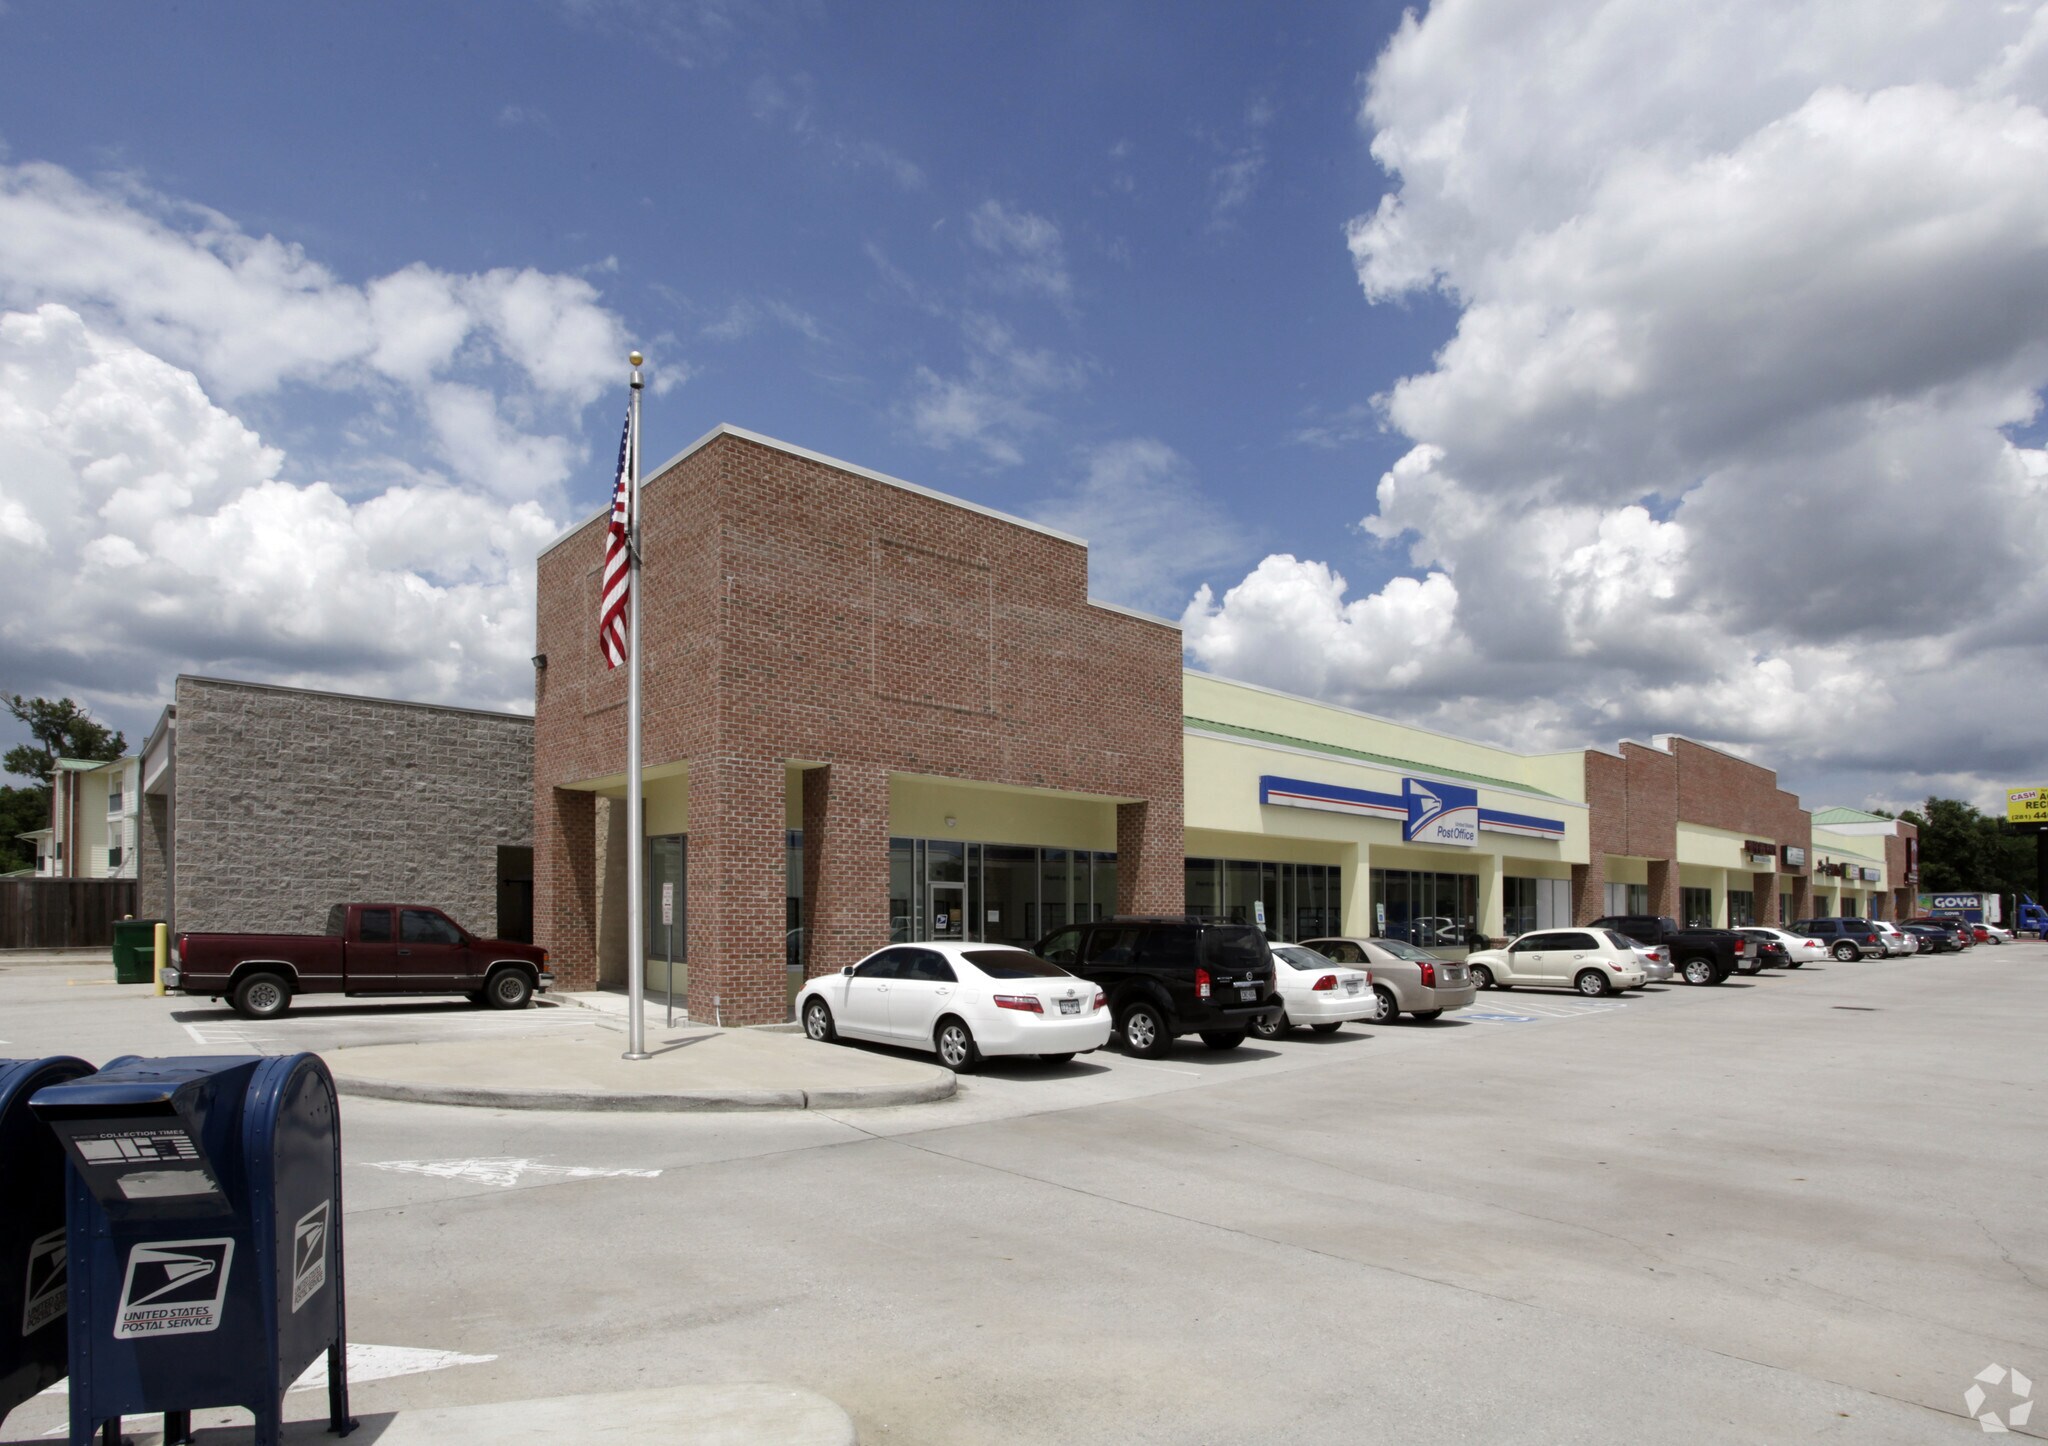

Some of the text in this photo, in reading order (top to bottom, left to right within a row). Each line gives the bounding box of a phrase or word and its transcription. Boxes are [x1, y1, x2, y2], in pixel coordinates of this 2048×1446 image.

[2010, 791, 2036, 801] CASH
[2025, 801, 2048, 809] REC
[2033, 811, 2048, 819] 44
[1437, 825, 1474, 840] Post Office
[1934, 897, 1979, 908] GOYA
[100, 1130, 157, 1138] COLLECTION
[123, 1306, 209, 1321] UNITED STATES
[121, 1316, 213, 1332] POSTAL SERVICE
